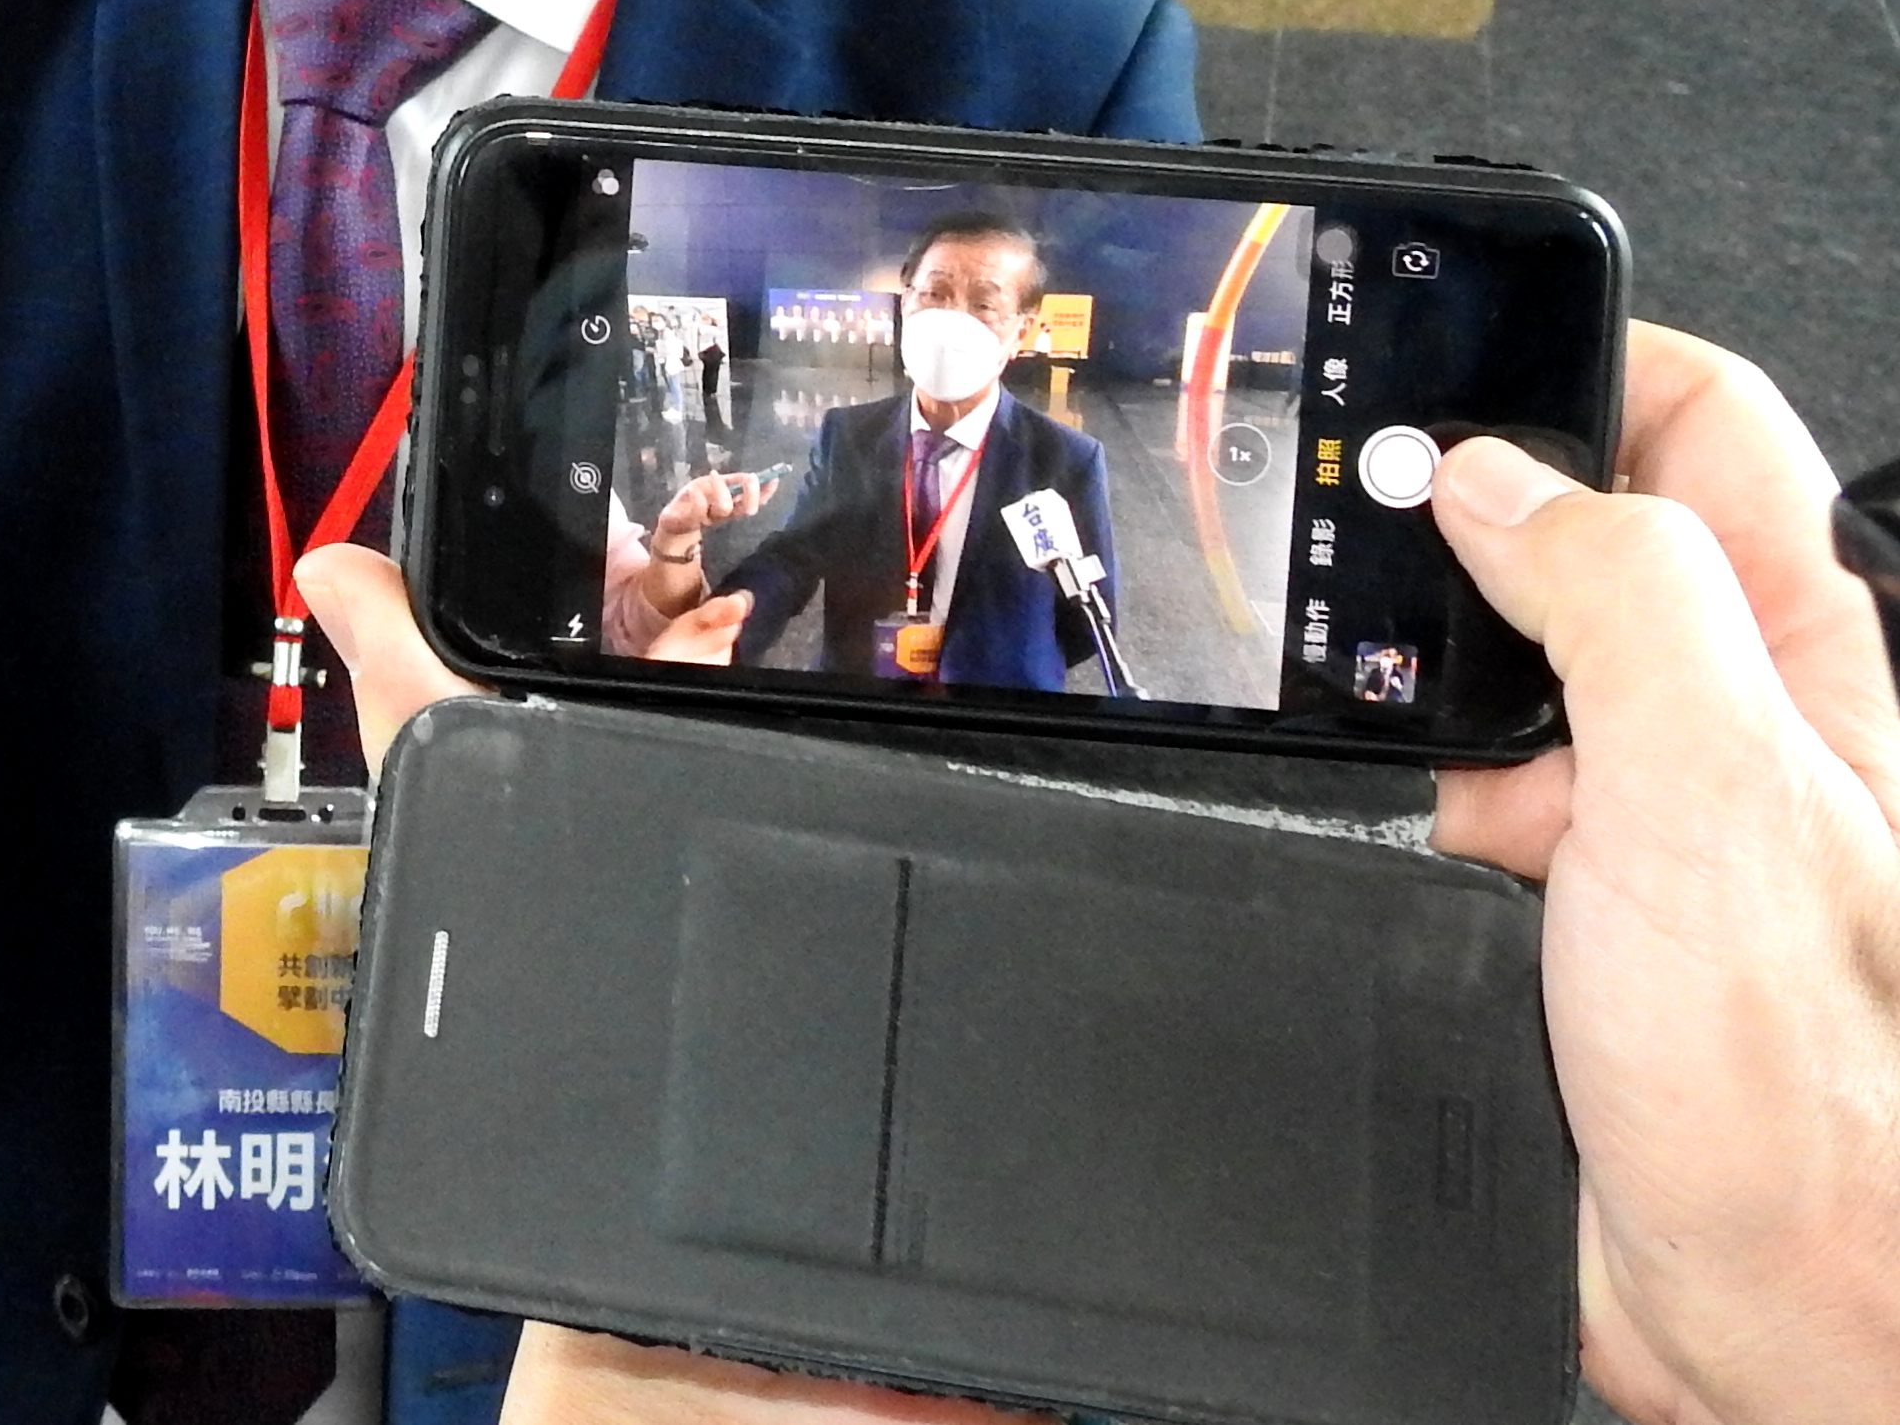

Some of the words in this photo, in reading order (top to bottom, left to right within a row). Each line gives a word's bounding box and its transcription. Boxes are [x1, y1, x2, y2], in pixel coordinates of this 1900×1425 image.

[1321, 357, 1350, 407] 人像
[1229, 446, 1251, 462] 1x
[1316, 437, 1343, 486] 拍照
[1309, 517, 1336, 567] 錄影
[153, 1128, 331, 1211] 林明
